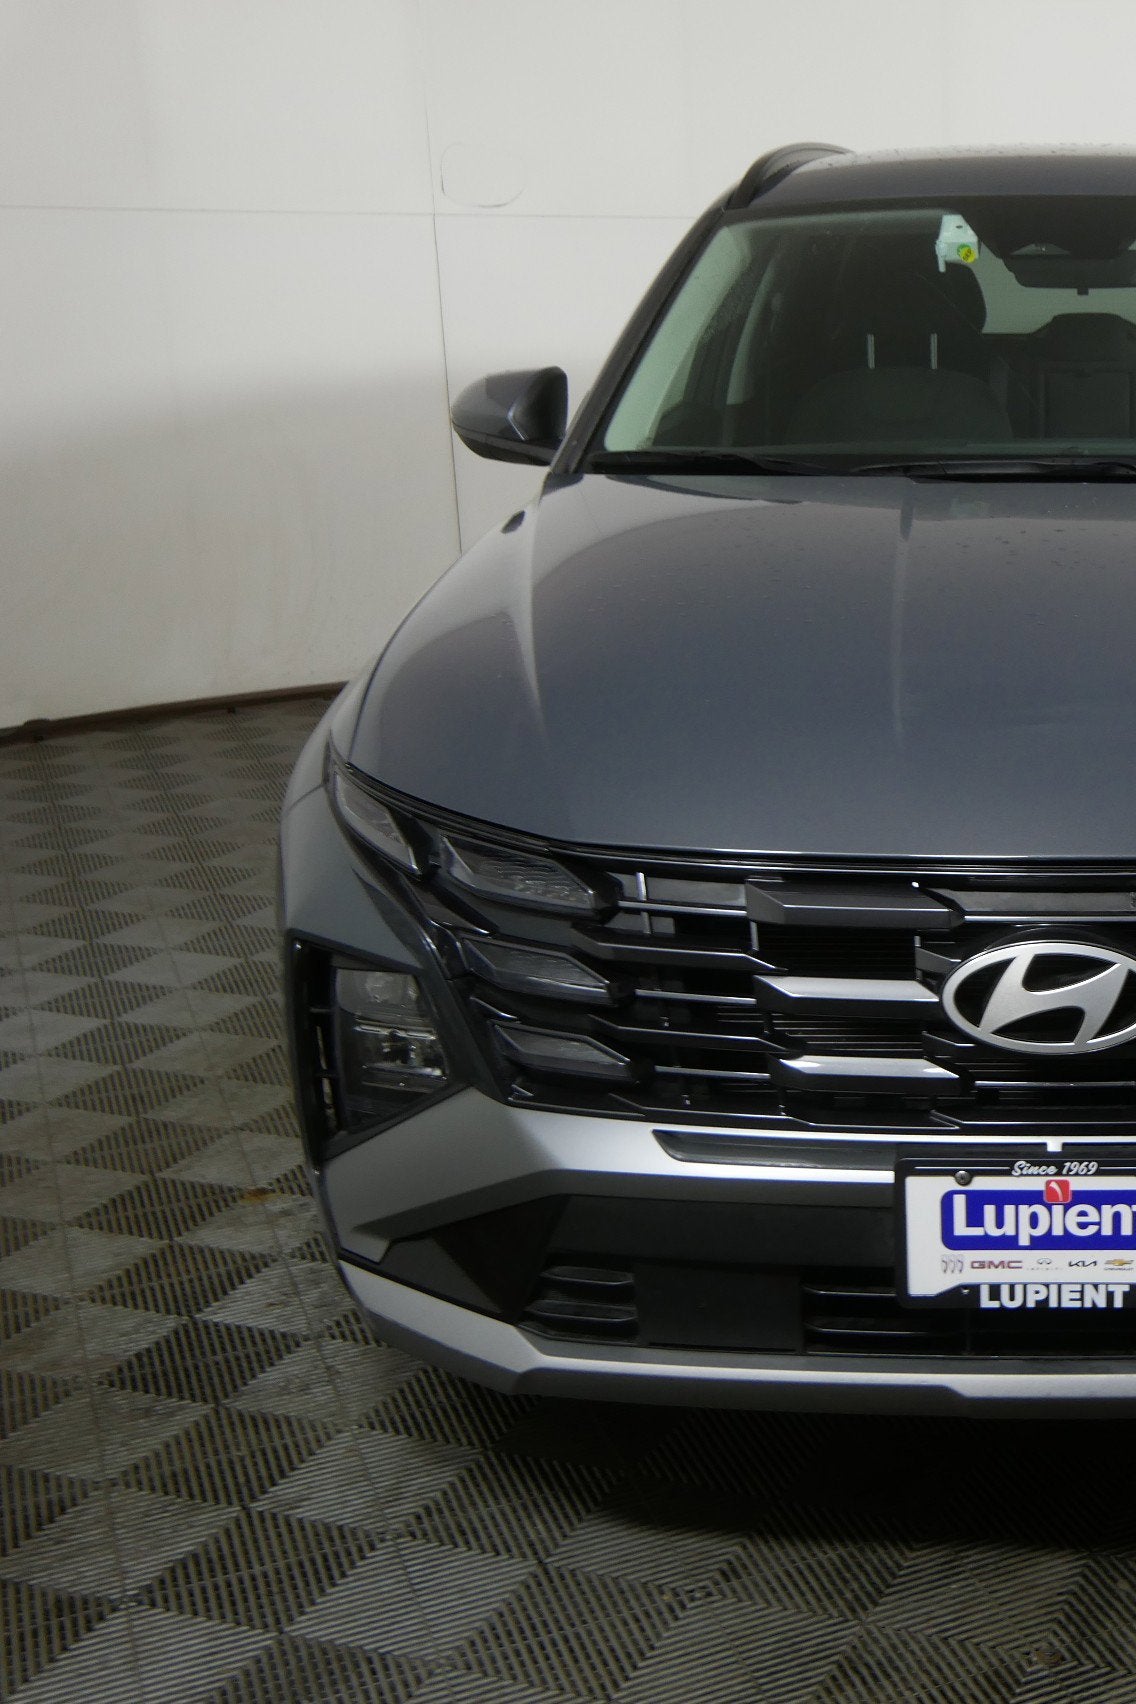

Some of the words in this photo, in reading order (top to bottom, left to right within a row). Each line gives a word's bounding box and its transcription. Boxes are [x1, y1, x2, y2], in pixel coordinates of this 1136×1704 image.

[1011, 1160, 1058, 1176] Since
[1062, 1161, 1099, 1175] 1969
[970, 1260, 1023, 1269] GMC
[980, 1284, 1130, 1309] LUPIENT
